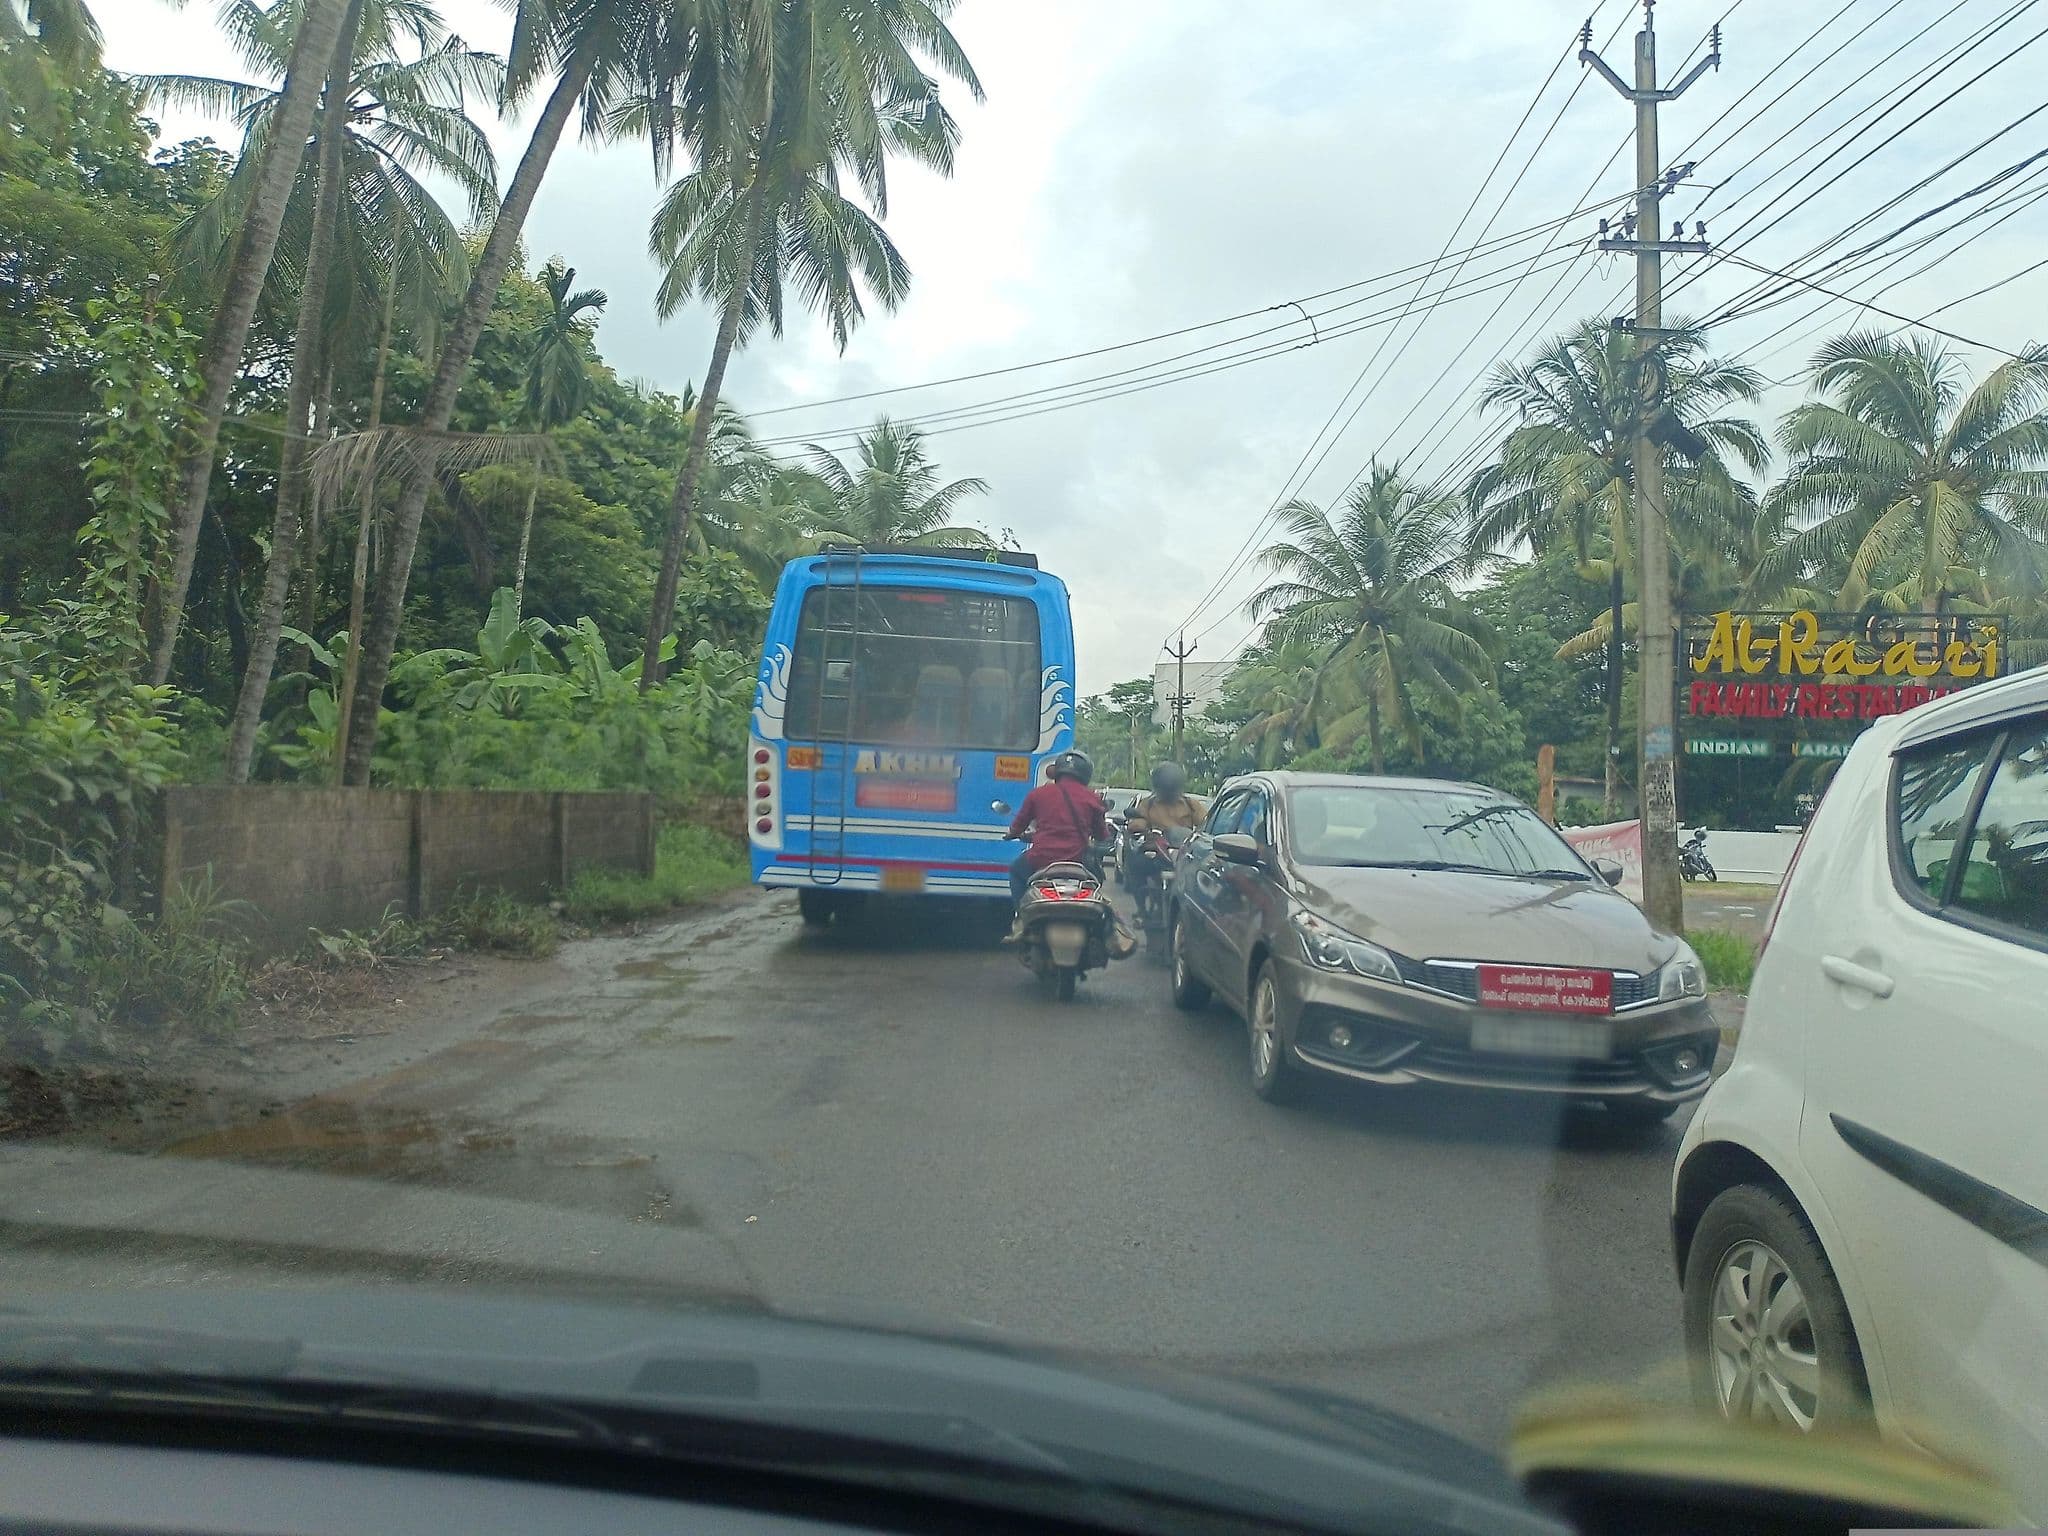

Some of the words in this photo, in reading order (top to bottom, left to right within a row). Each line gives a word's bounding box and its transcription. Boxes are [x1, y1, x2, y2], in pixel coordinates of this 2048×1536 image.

[1690, 682, 1791, 717] FAMILY
[1797, 684, 1961, 719] RESTAUR
[1691, 741, 1768, 754] INDIAN
